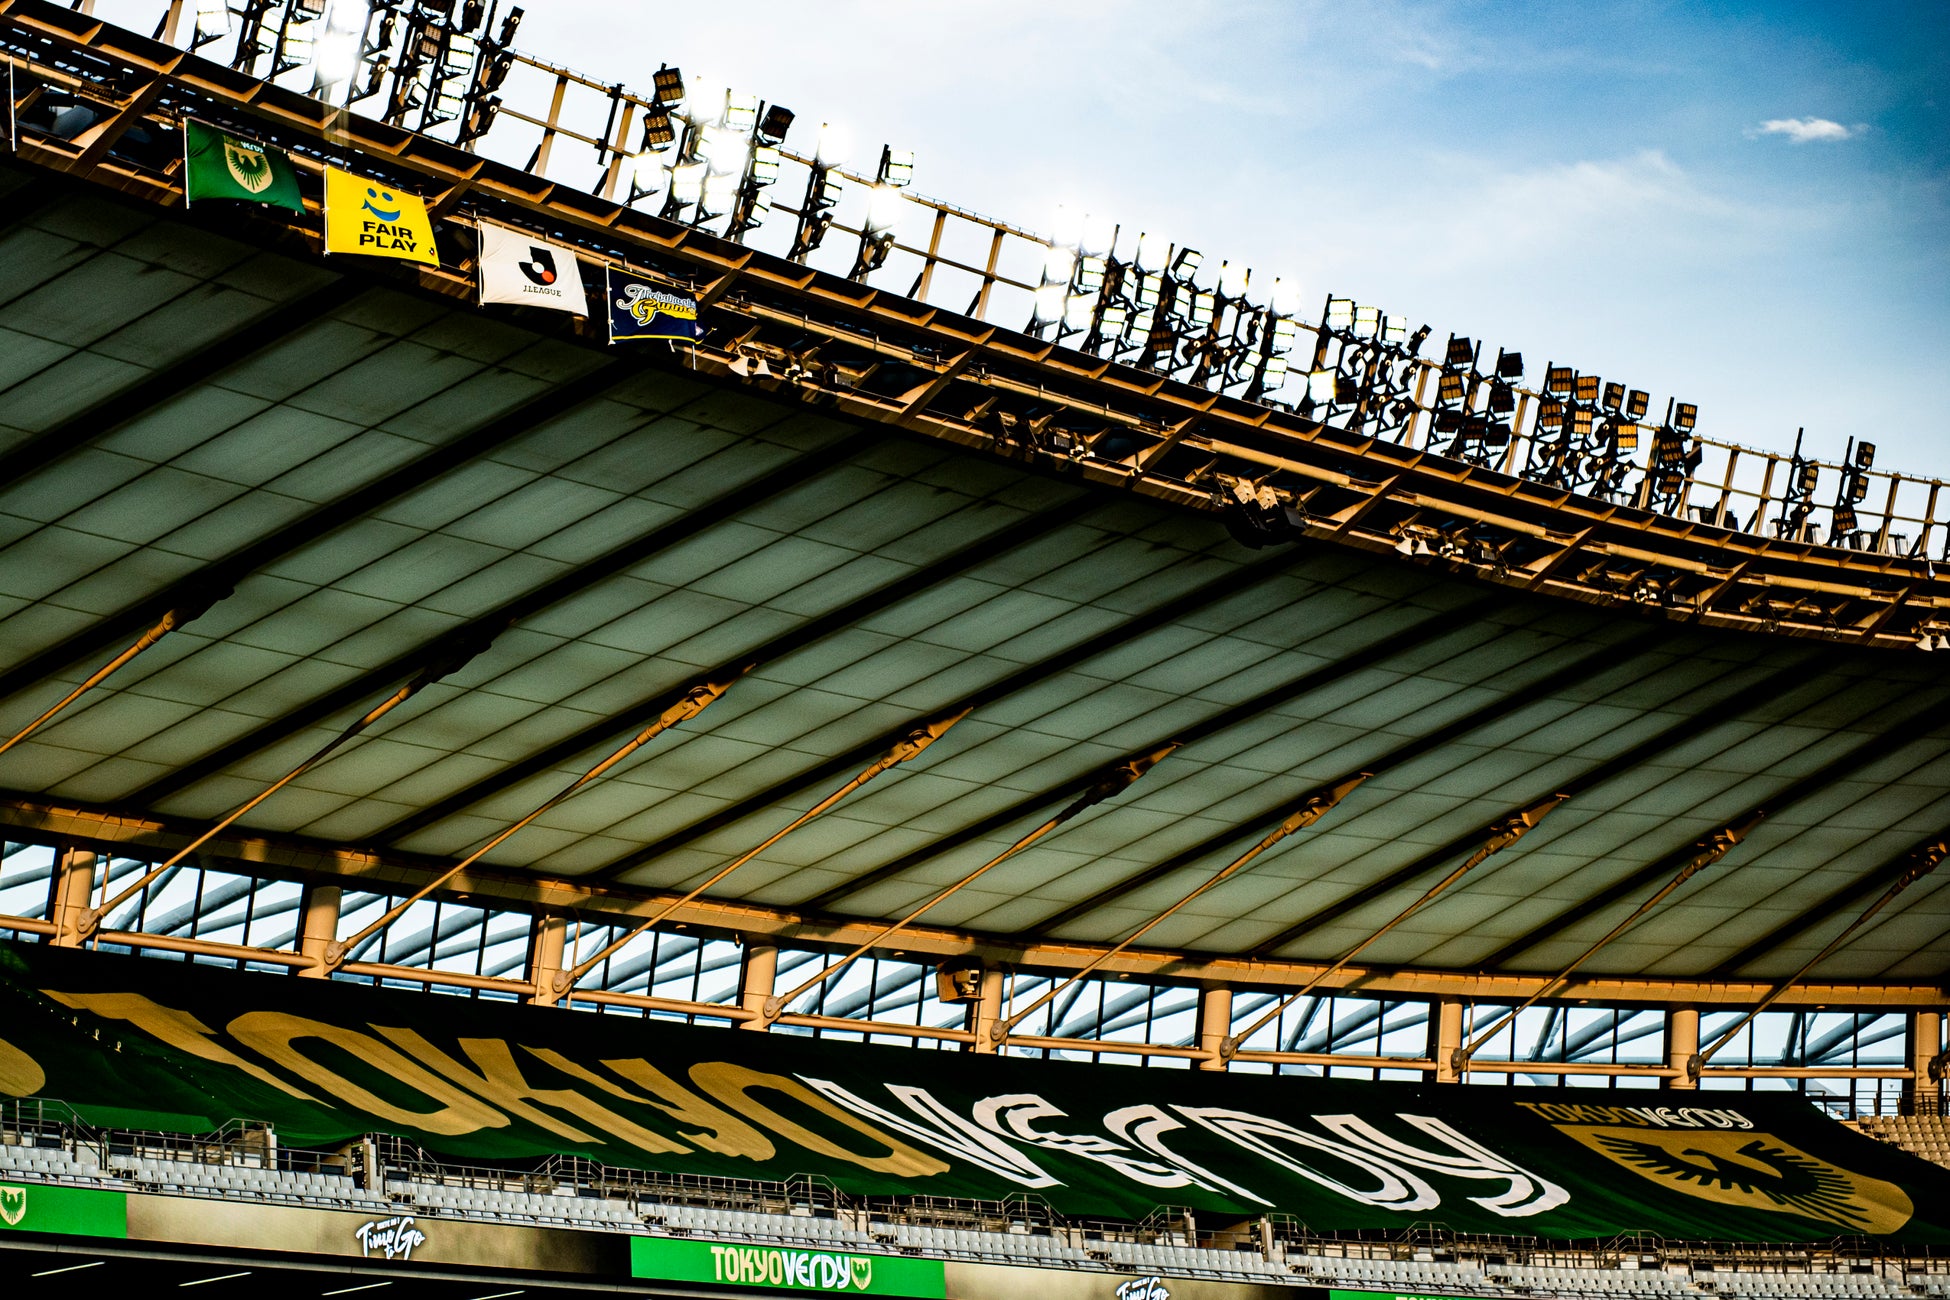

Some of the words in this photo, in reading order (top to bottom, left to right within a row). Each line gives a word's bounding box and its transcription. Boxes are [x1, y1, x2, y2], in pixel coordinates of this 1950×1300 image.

[363, 221, 413, 240] FAIR
[359, 234, 417, 252] PLAY
[355, 1222, 395, 1258] Time
[393, 1216, 426, 1261] Go
